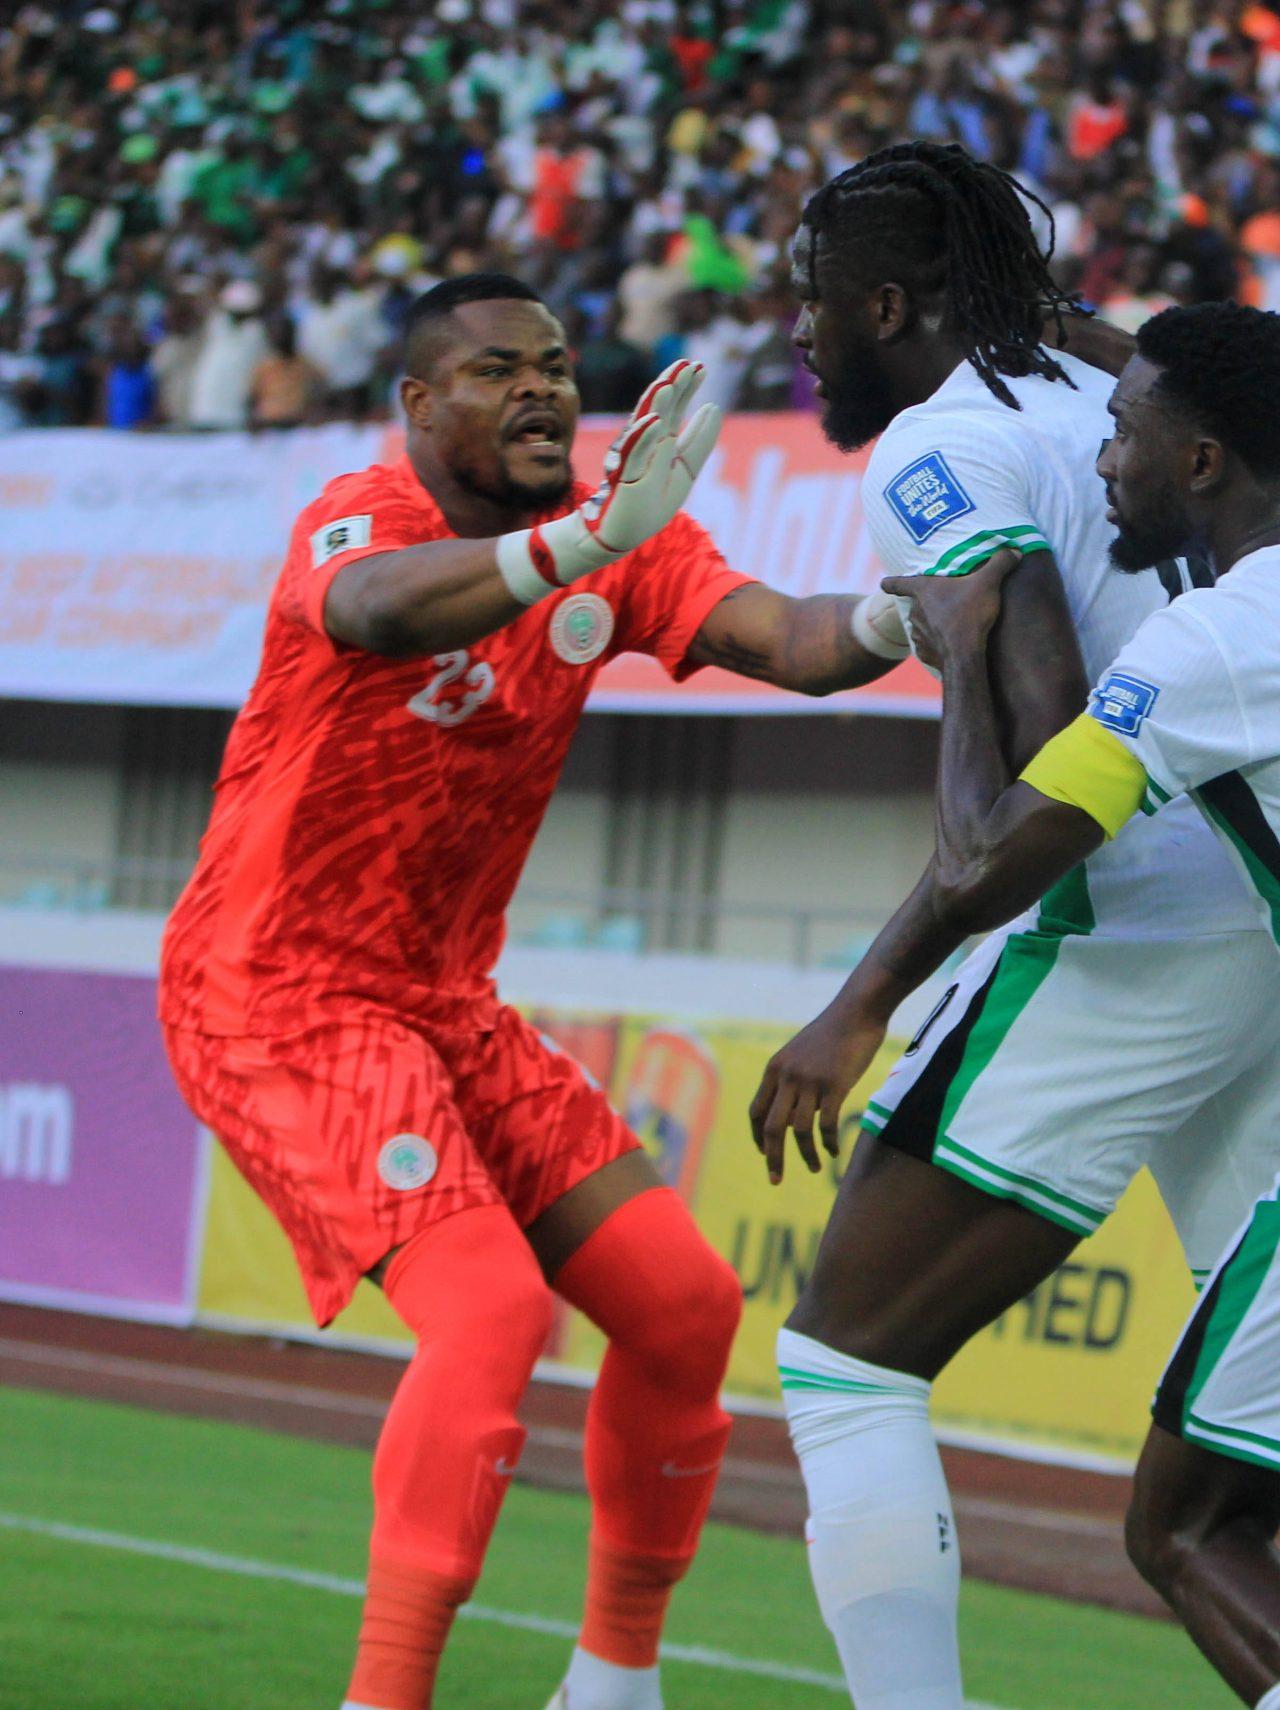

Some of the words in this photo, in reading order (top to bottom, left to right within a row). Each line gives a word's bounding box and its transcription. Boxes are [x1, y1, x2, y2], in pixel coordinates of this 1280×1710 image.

[896, 466, 934, 495] FOOTBALL
[901, 473, 940, 506] UNITES
[407, 650, 496, 727] 23
